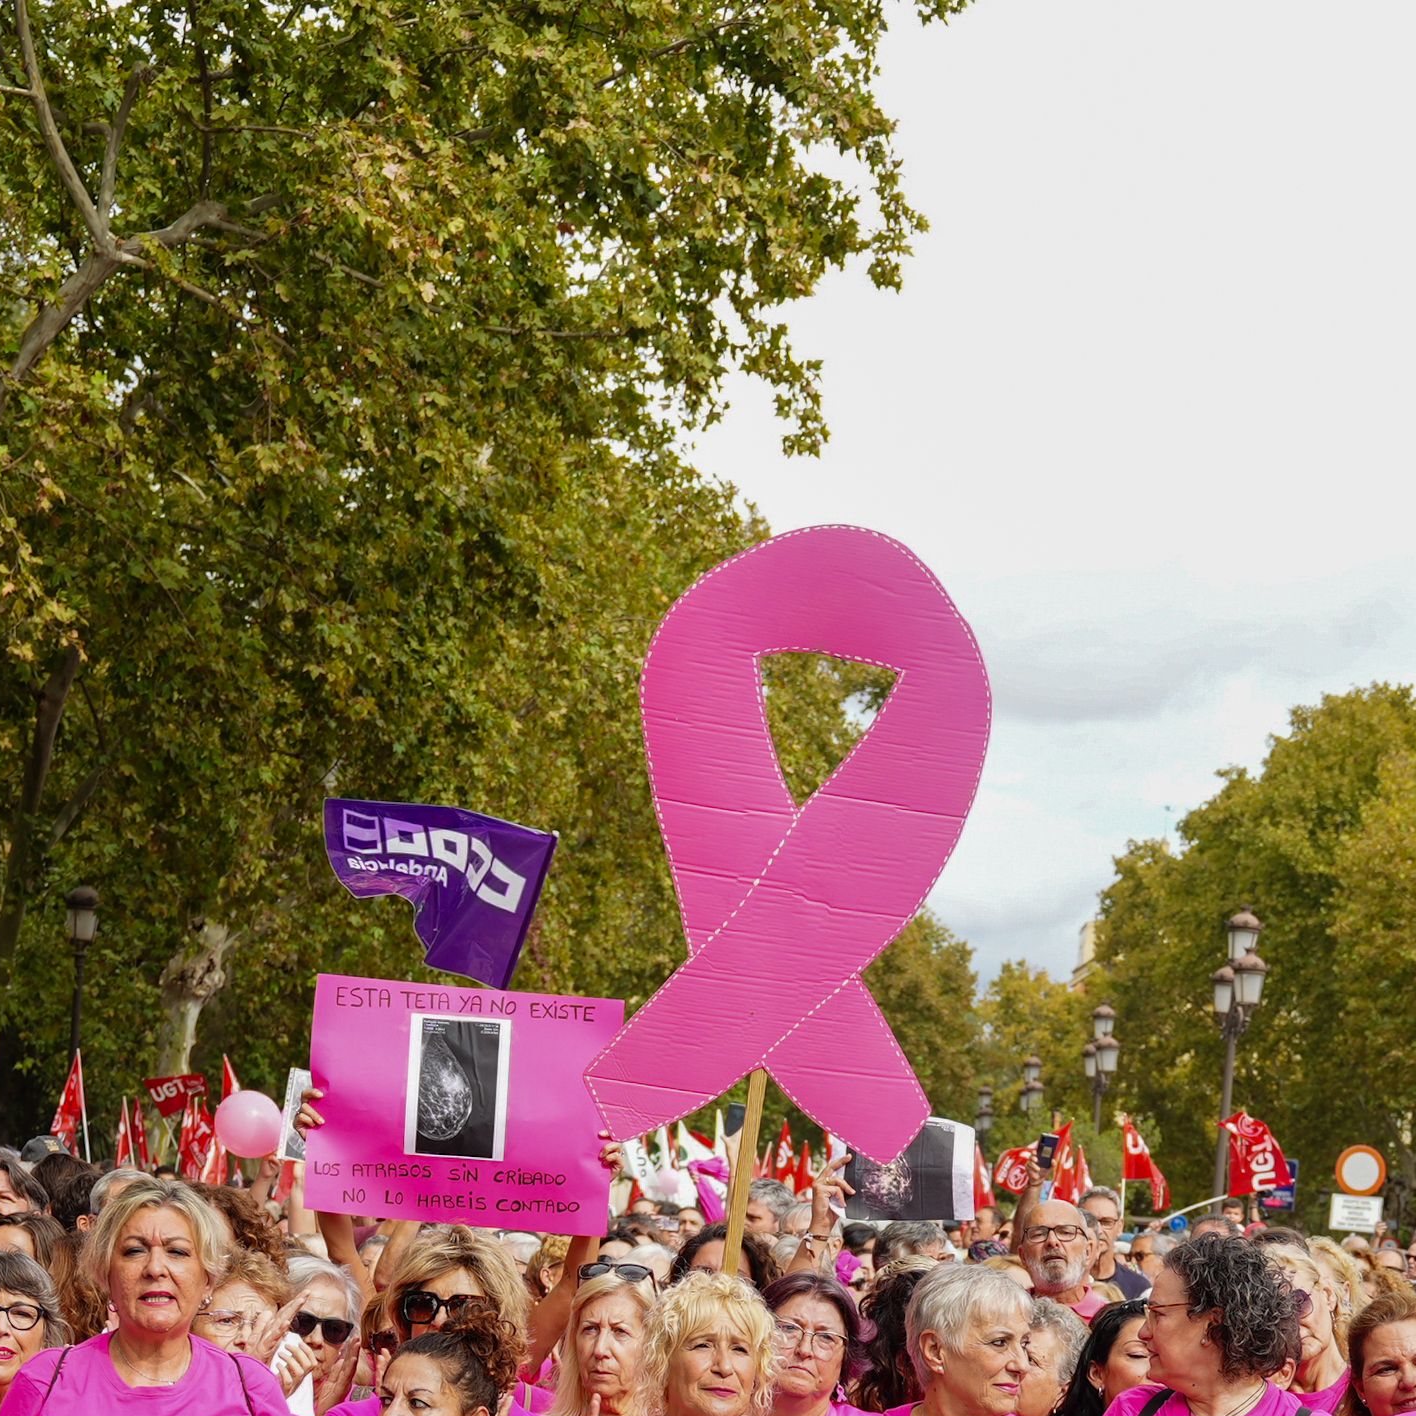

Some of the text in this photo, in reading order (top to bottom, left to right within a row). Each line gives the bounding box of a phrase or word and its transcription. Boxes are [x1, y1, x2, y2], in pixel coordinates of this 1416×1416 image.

[336, 986, 391, 1009] ESTA
[400, 991, 451, 1010] TETA
[459, 995, 482, 1013] YA
[490, 996, 517, 1015] NO
[150, 1079, 186, 1103] UGT
[314, 1160, 341, 1177] LOS
[352, 1162, 432, 1179] ATRASOS
[342, 1188, 366, 1204] NO
[384, 1190, 404, 1205] LO
[495, 1198, 581, 1213] CONTADO
